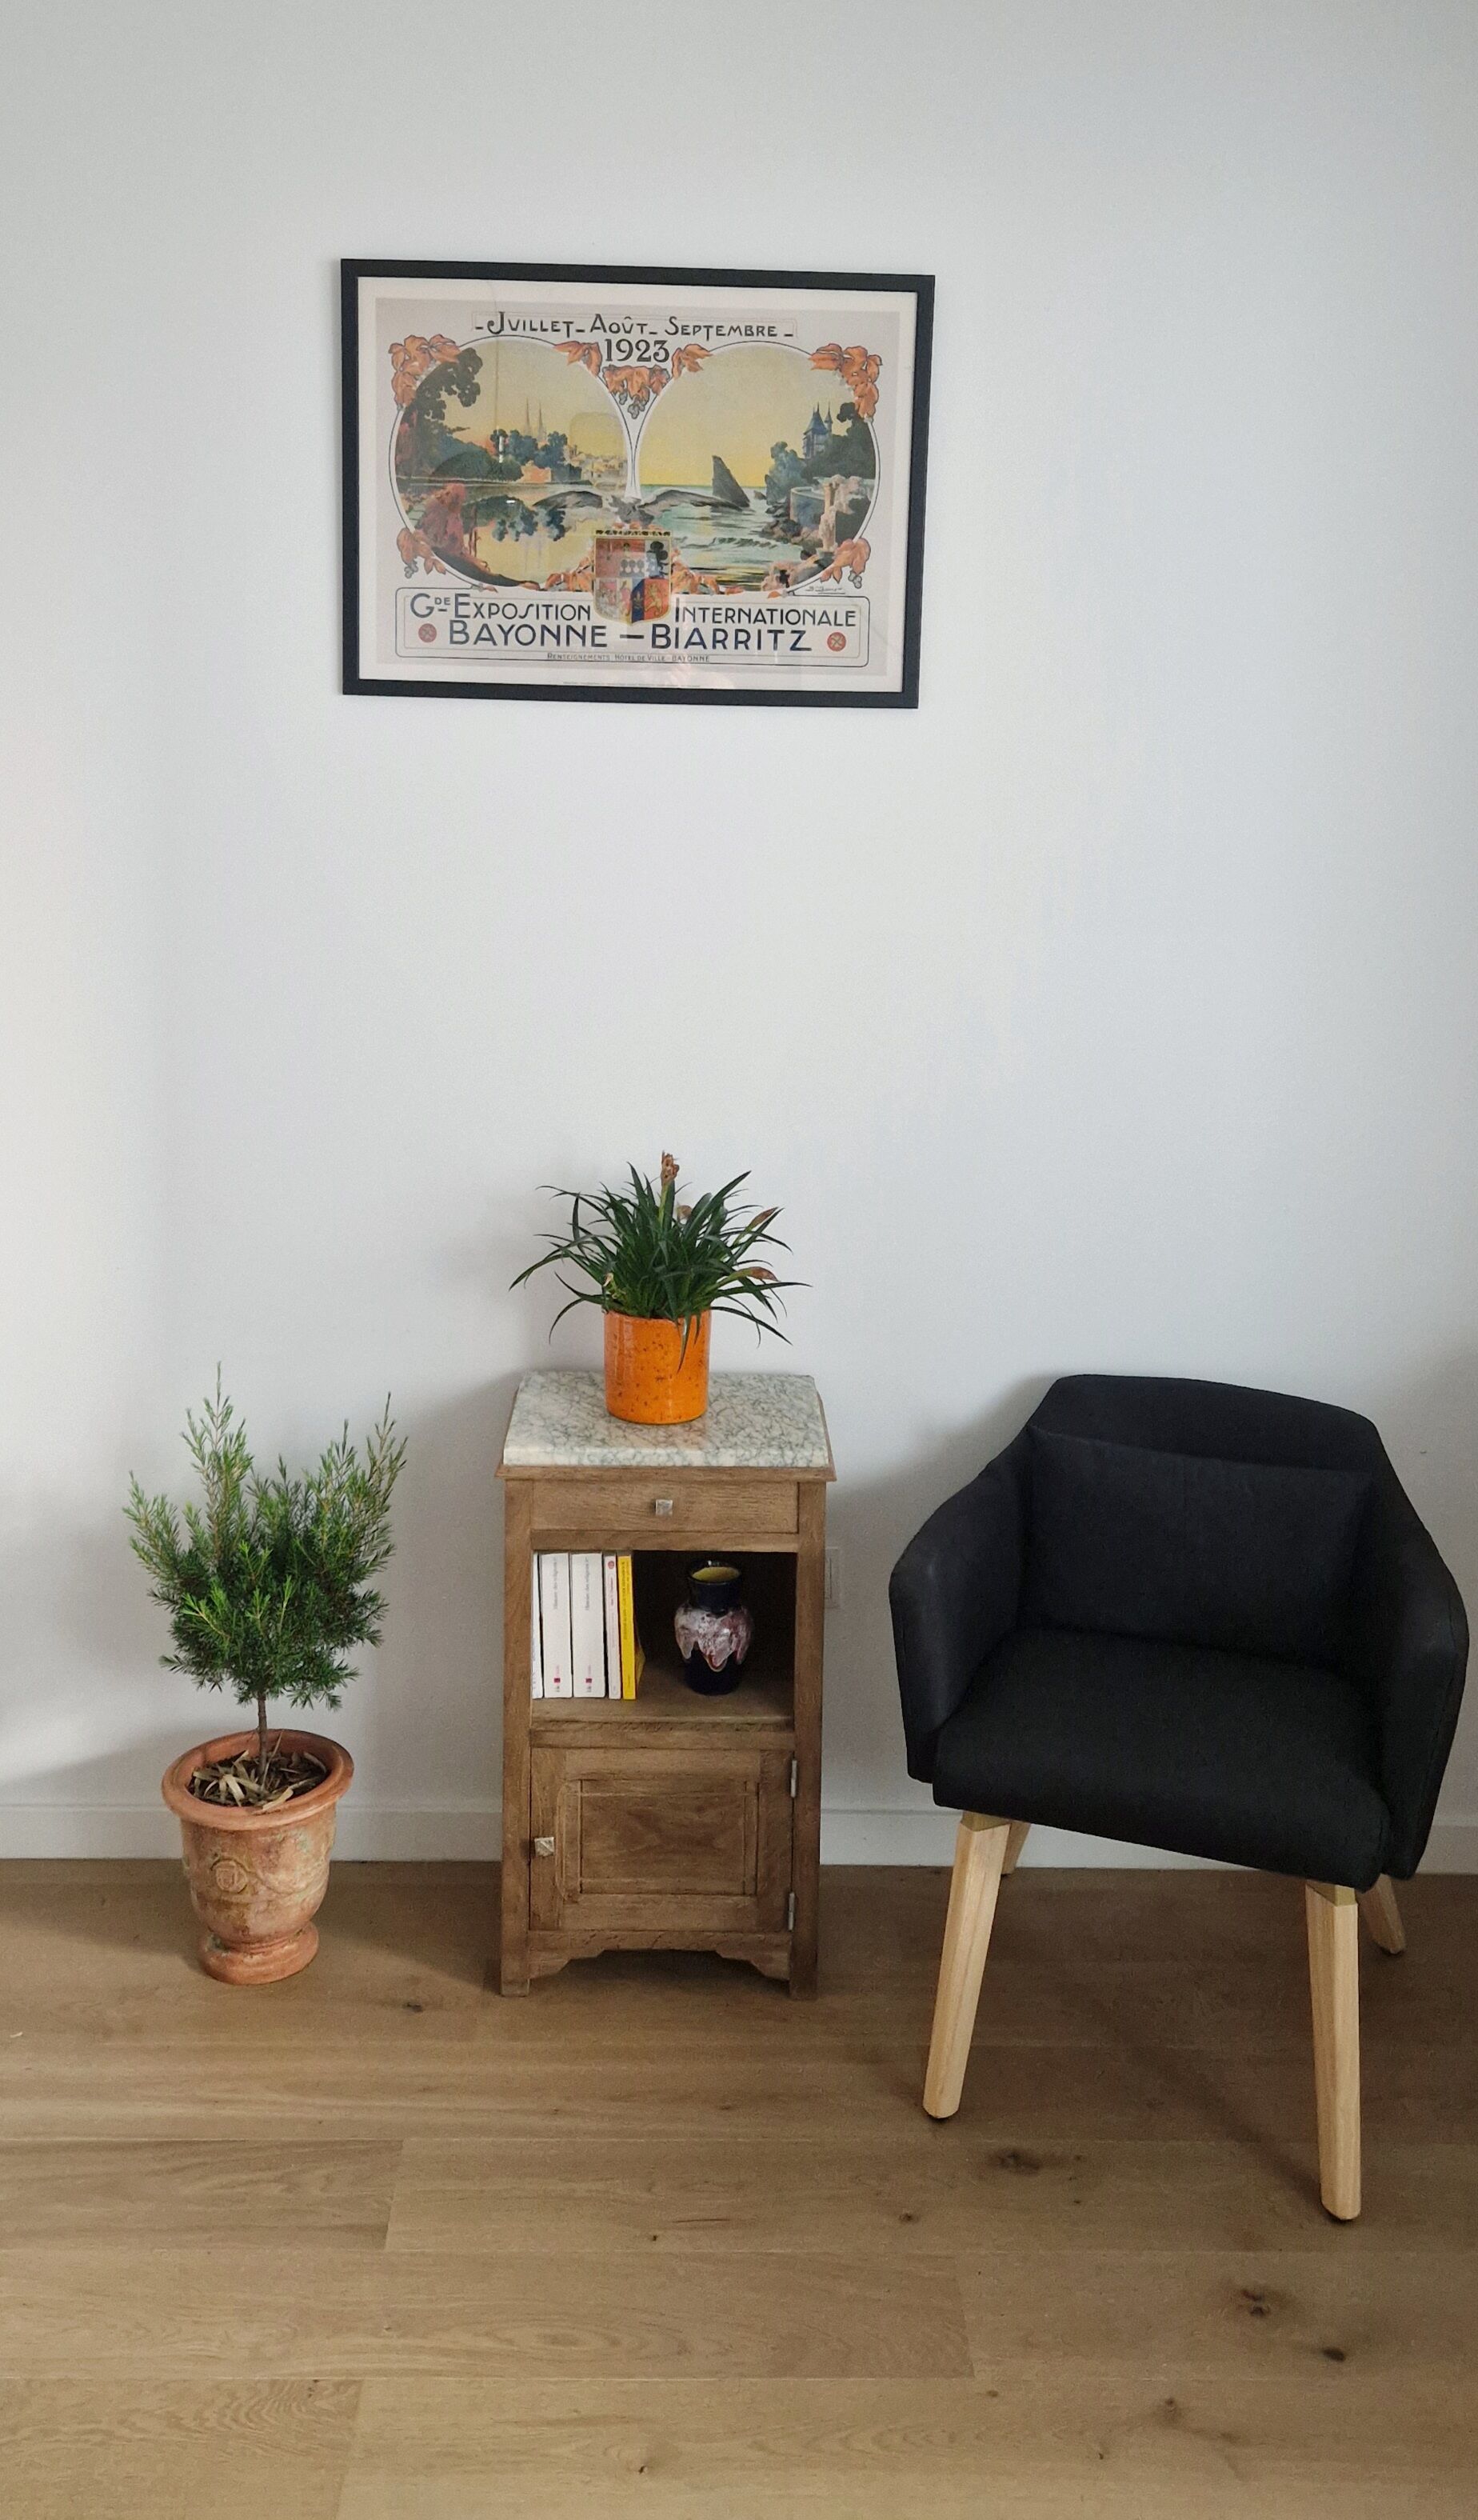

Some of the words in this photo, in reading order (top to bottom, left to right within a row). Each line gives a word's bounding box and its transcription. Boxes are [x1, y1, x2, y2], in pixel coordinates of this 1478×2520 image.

[665, 316, 777, 342] SEPTEMBRE
[604, 338, 670, 362] 1923
[454, 593, 591, 622] EXPOSITION
[674, 598, 857, 627] INTERNATIONALE
[449, 619, 608, 647] BAYONNE
[651, 623, 813, 652] BIARRITZ
[671, 654, 710, 663] BAYONNE
